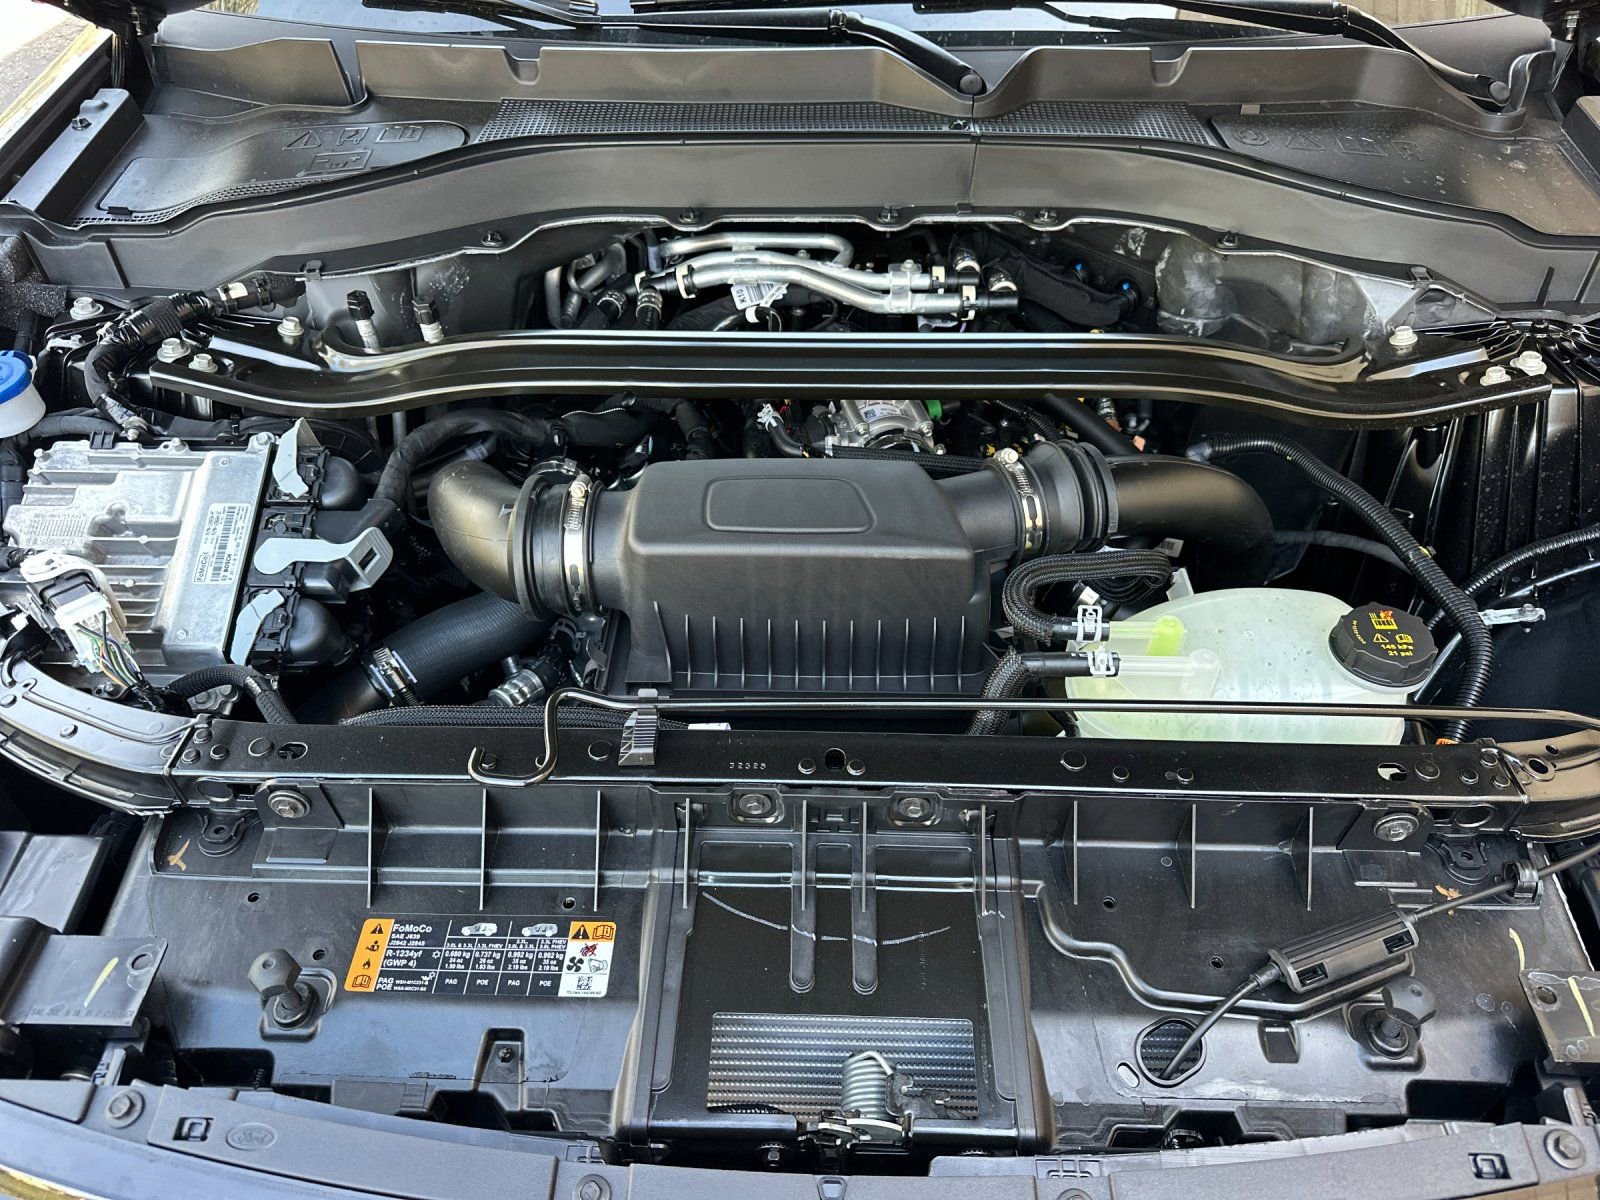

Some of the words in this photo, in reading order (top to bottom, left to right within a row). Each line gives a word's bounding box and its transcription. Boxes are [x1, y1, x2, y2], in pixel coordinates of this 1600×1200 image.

[223, 553, 232, 573] BOSCH
[196, 555, 209, 581] FoMoCo
[392, 924, 433, 933] FoMoCo
[386, 950, 423, 959] R-1234yf
[462, 951, 471, 959] kg
[475, 951, 492, 959] 0.737
[492, 952, 501, 960] kg
[525, 952, 533, 960] kg
[555, 953, 564, 961] kg
[383, 959, 408, 968] (GWP
[407, 959, 417, 968] 4)
[376, 983, 392, 991] POE
